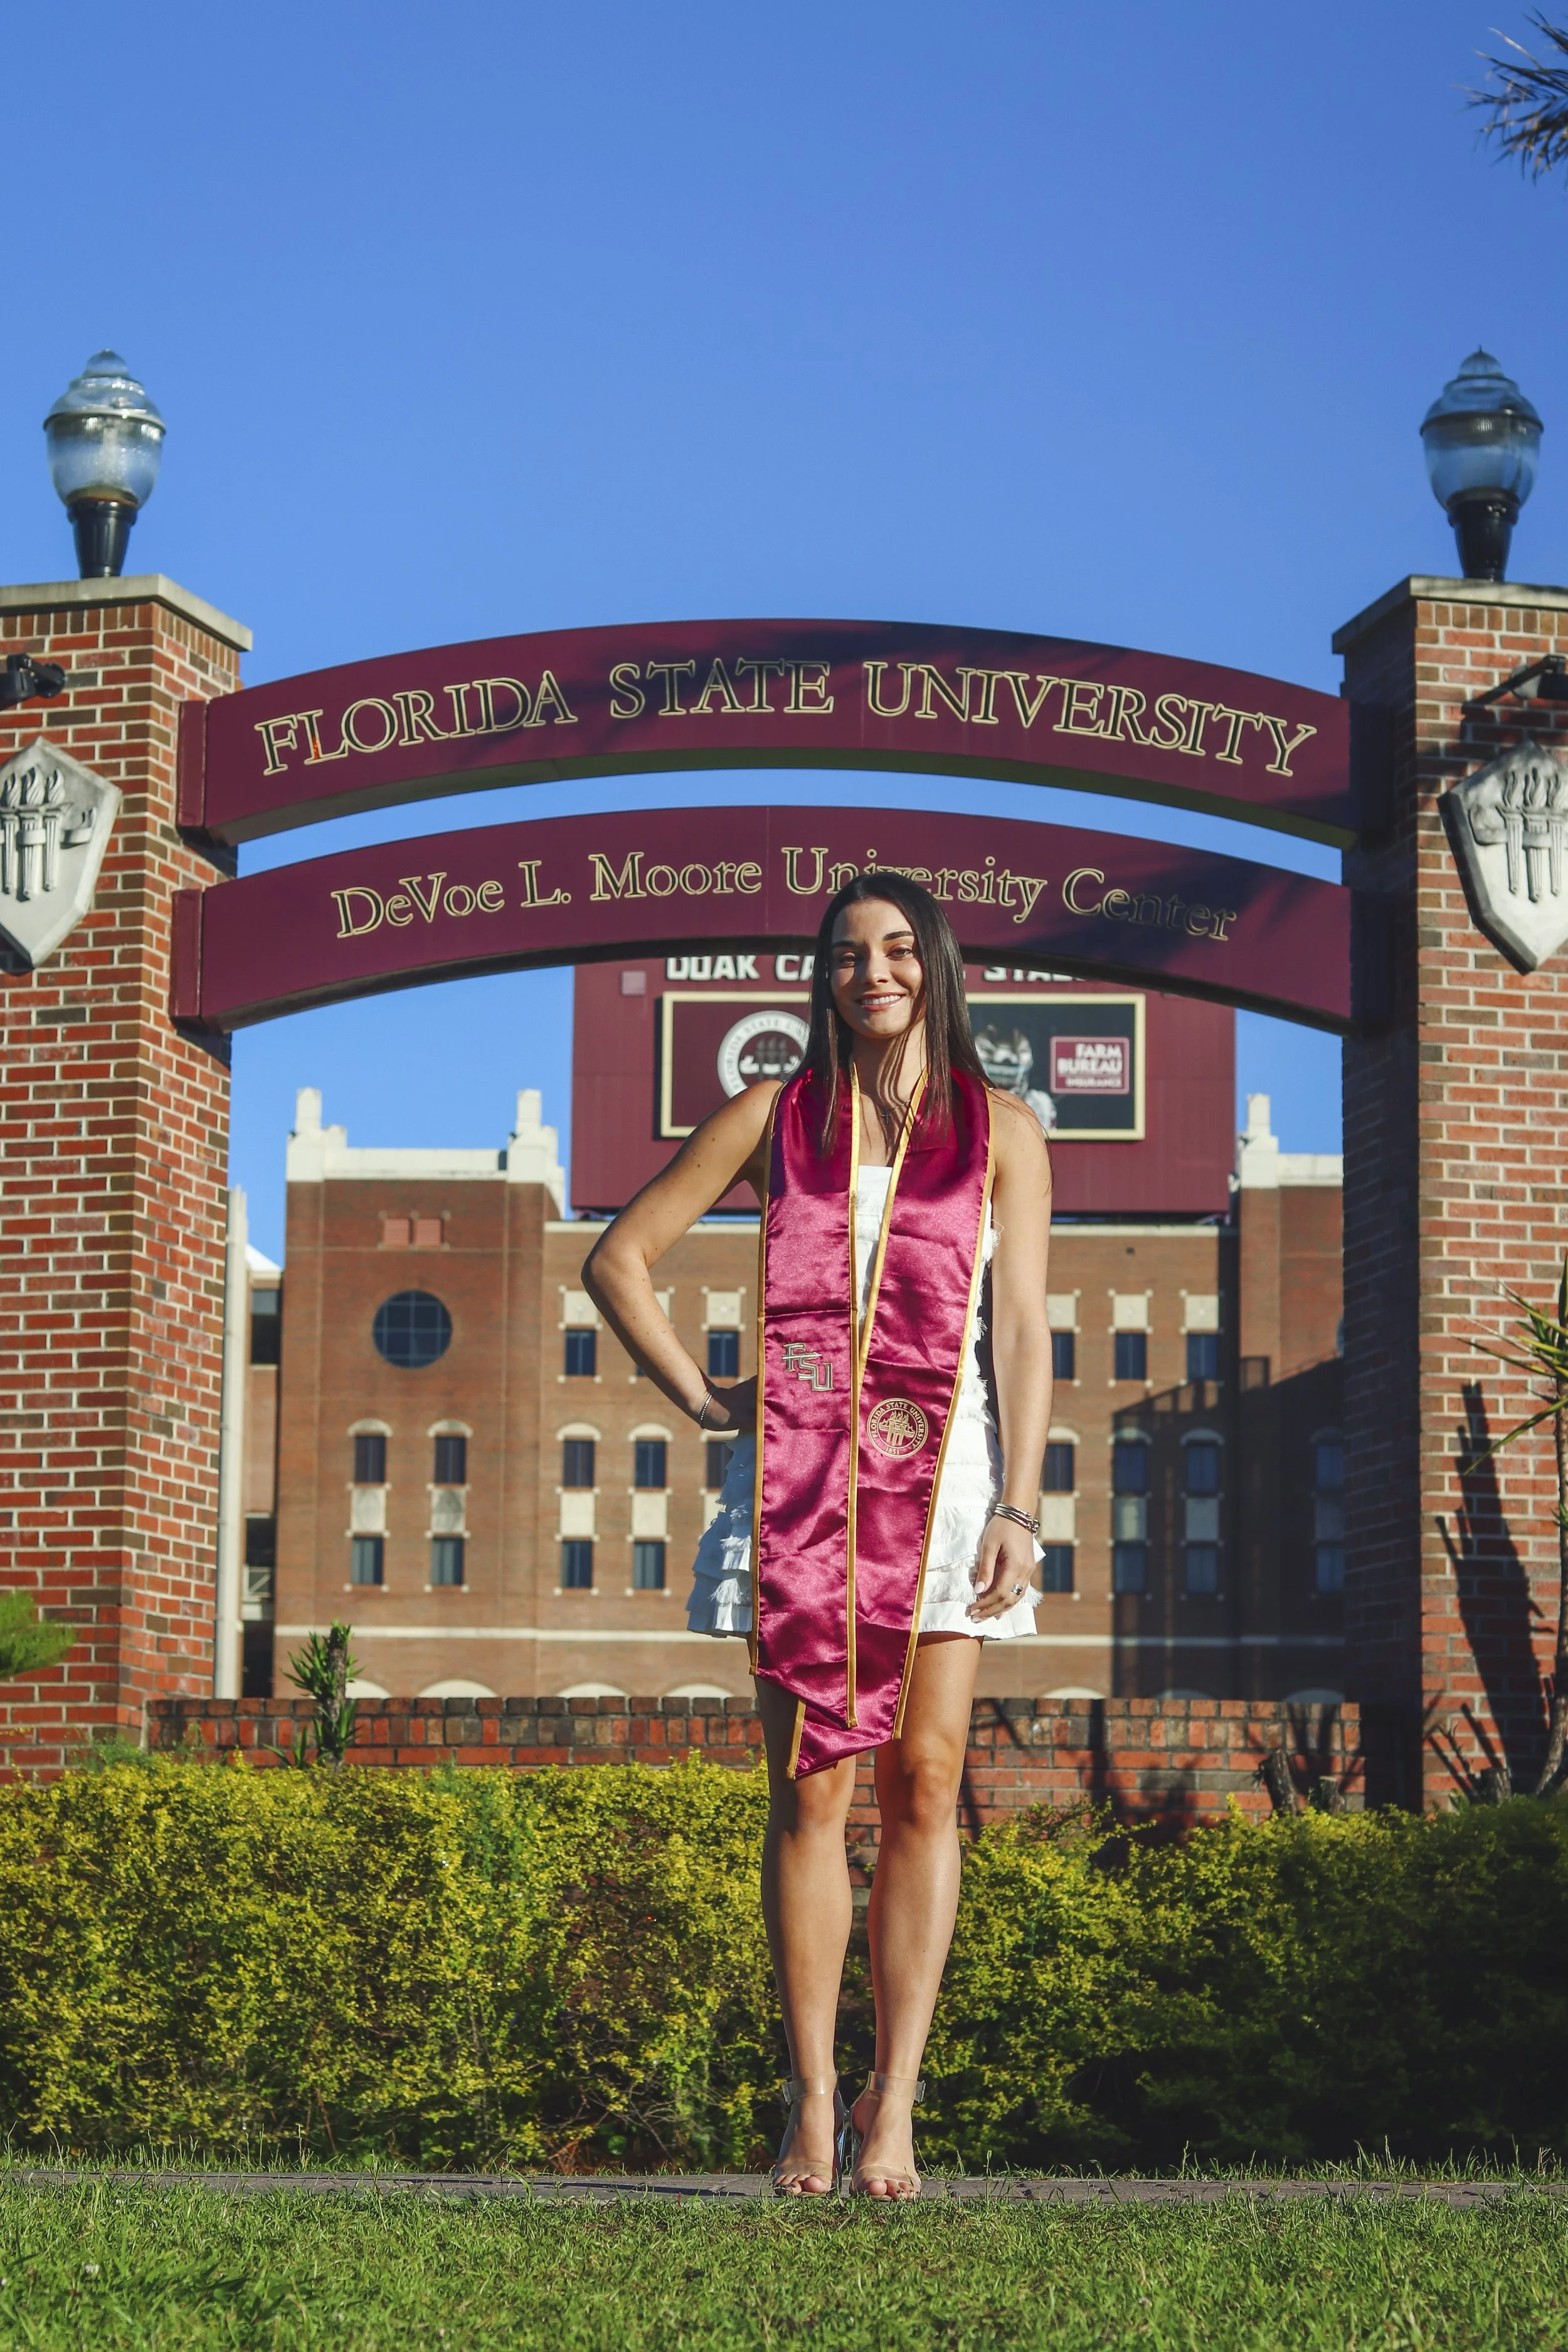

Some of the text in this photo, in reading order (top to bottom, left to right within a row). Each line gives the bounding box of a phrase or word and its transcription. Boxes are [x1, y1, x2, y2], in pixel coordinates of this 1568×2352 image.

[253, 657, 1317, 777] FLORIDA STATE UNIVERSITY
[331, 847, 1237, 941] DeVoe L. Moore Uniersity Center
[1056, 1057, 1123, 1075] BUREAU
[1075, 1042, 1122, 1058] FARM
[782, 1342, 835, 1392] FSU
[871, 1407, 885, 1439] FLORIDA
[909, 1407, 925, 1449] UNIVERSITY
[885, 1446, 900, 1454] 1851
